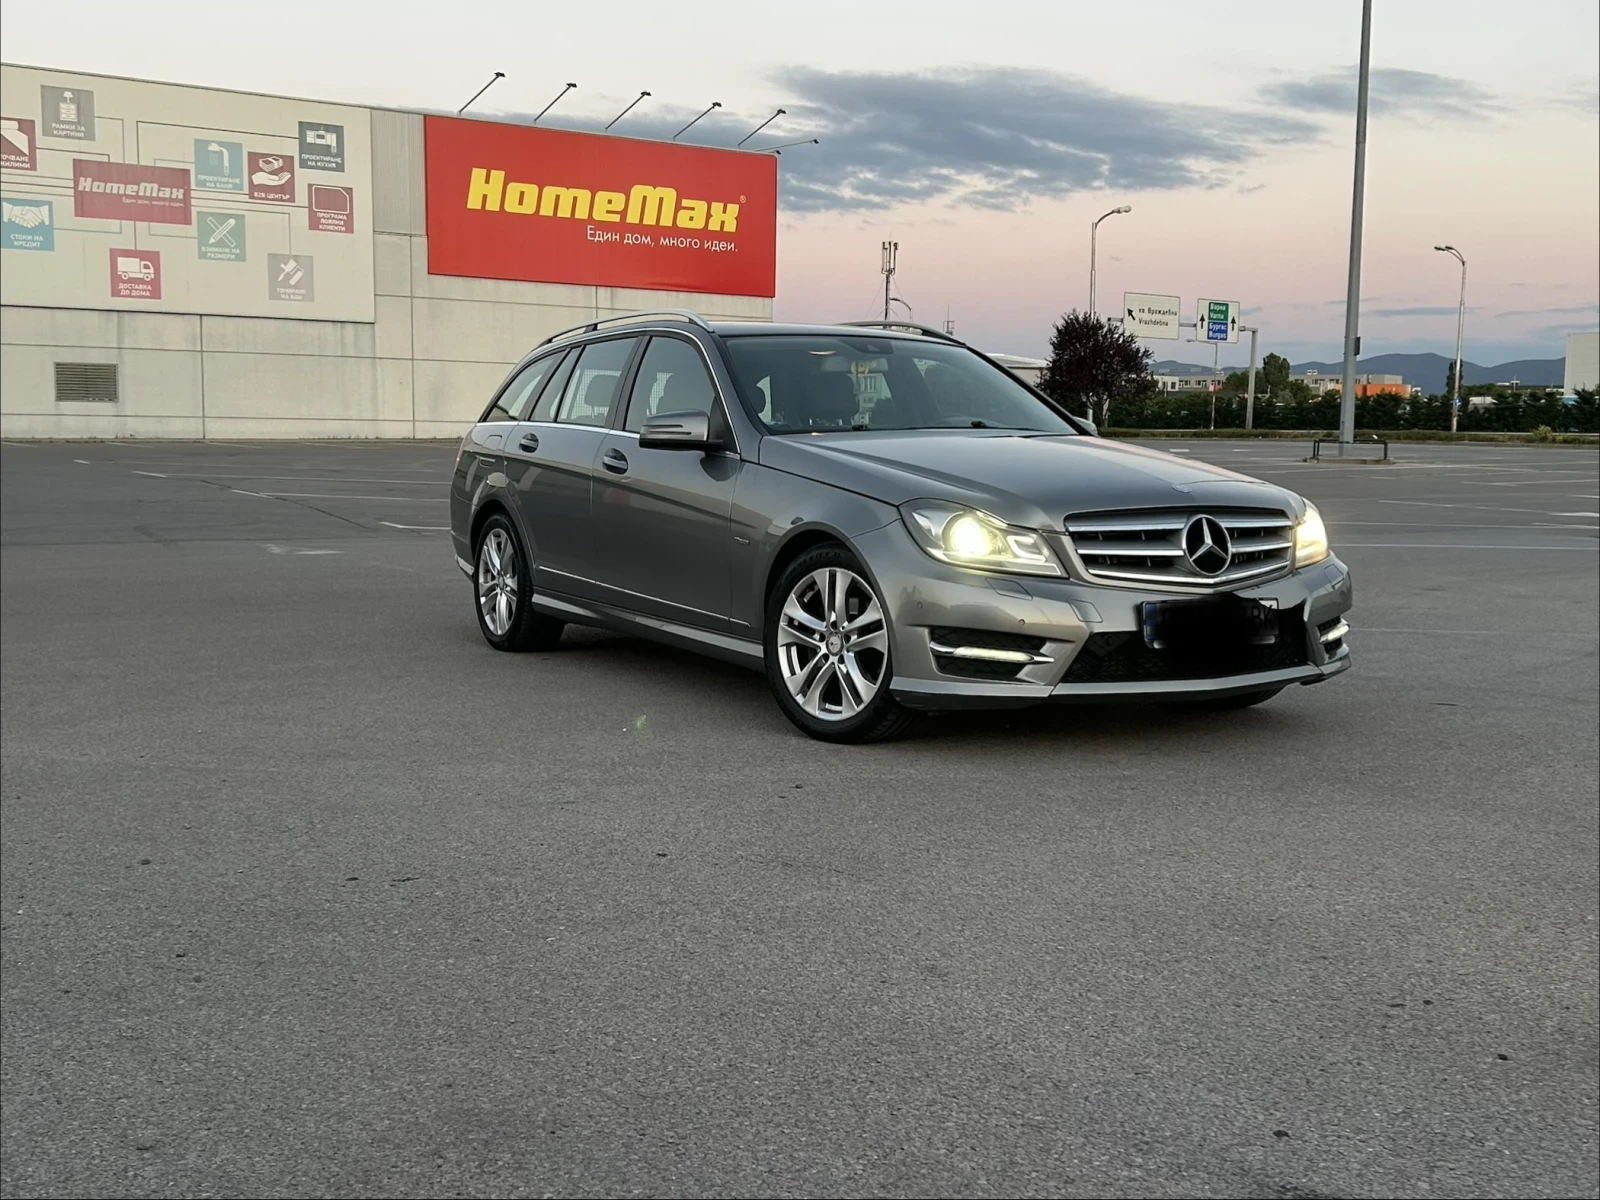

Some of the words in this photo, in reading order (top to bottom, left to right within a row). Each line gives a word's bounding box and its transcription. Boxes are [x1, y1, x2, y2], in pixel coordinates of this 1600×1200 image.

[302, 154, 342, 163] ПРОЕКТИРАНЕ
[78, 176, 184, 200] HomeMax
[466, 167, 740, 233] HomeMax
[586, 225, 620, 243] Един
[623, 233, 655, 247] дом,
[659, 236, 700, 249] много
[704, 240, 738, 252] идеи.
[118, 282, 152, 290] ДОСТАВКА
[120, 289, 130, 297] ДО
[130, 290, 151, 298] ДОМА
